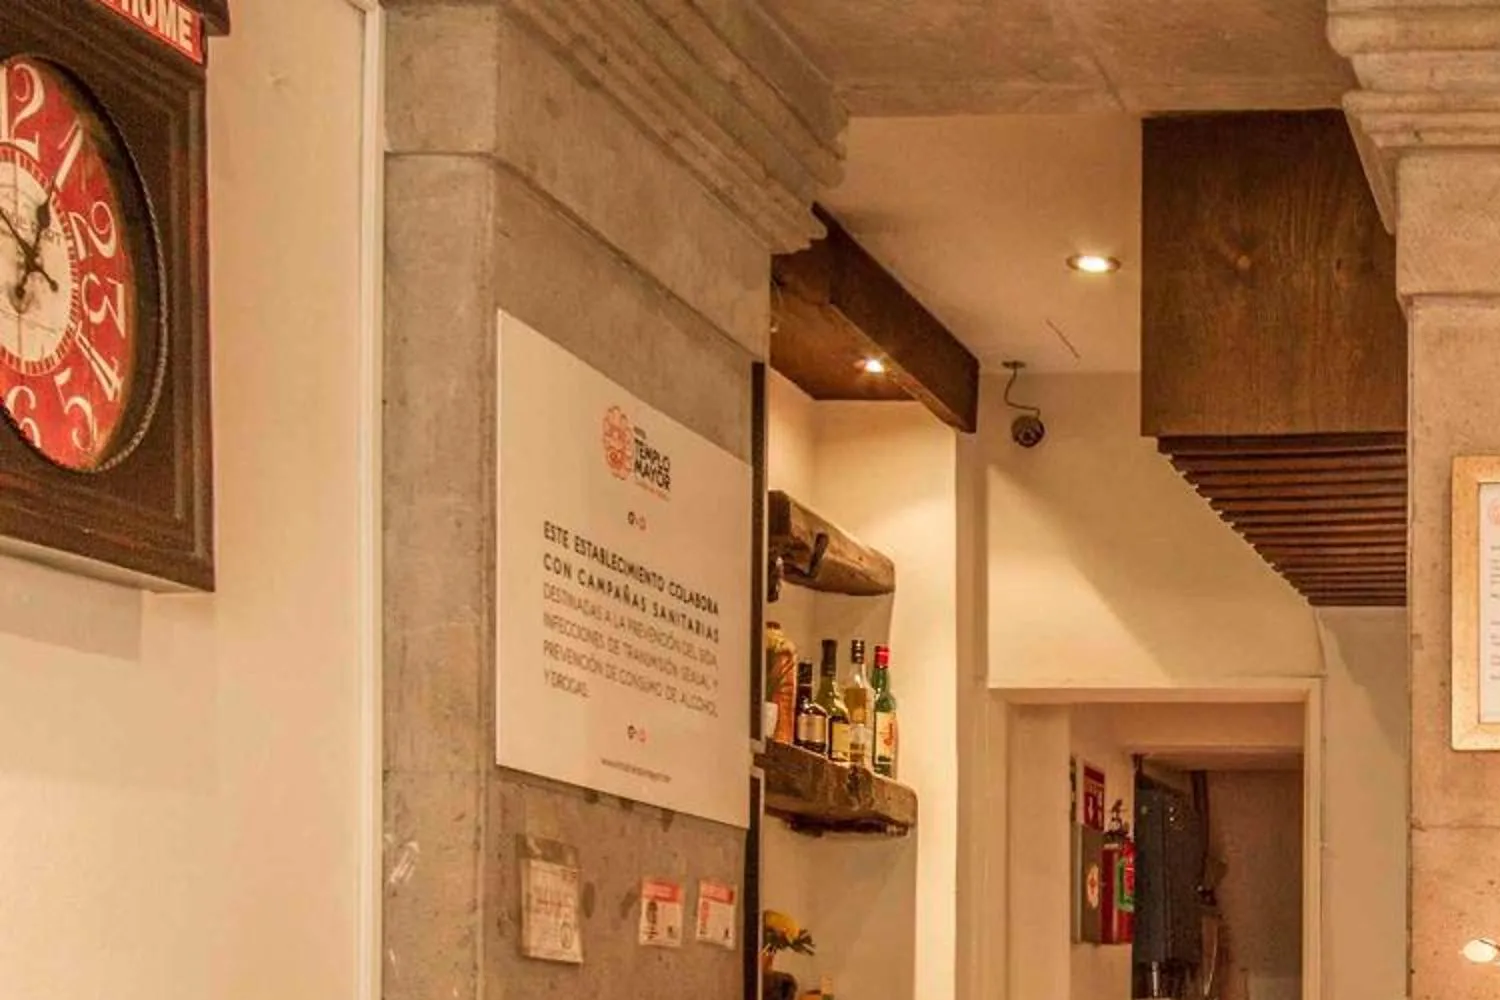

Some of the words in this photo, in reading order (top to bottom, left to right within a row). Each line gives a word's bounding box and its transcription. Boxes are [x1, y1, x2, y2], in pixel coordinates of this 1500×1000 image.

[69, 201, 117, 260] 2
[81, 272, 126, 340] 3
[75, 320, 124, 401] 4
[54, 367, 98, 451] 5
[634, 437, 670, 474] TEMPLO
[634, 456, 670, 493] MAYOR
[543, 553, 571, 579] CON
[578, 565, 645, 611] CAMPAÑAS
[652, 602, 718, 643] SANITARIAS
[544, 521, 569, 548] ESTE
[574, 536, 663, 592] ESTABLECIMIENTO
[669, 579, 718, 616] COLABORA
